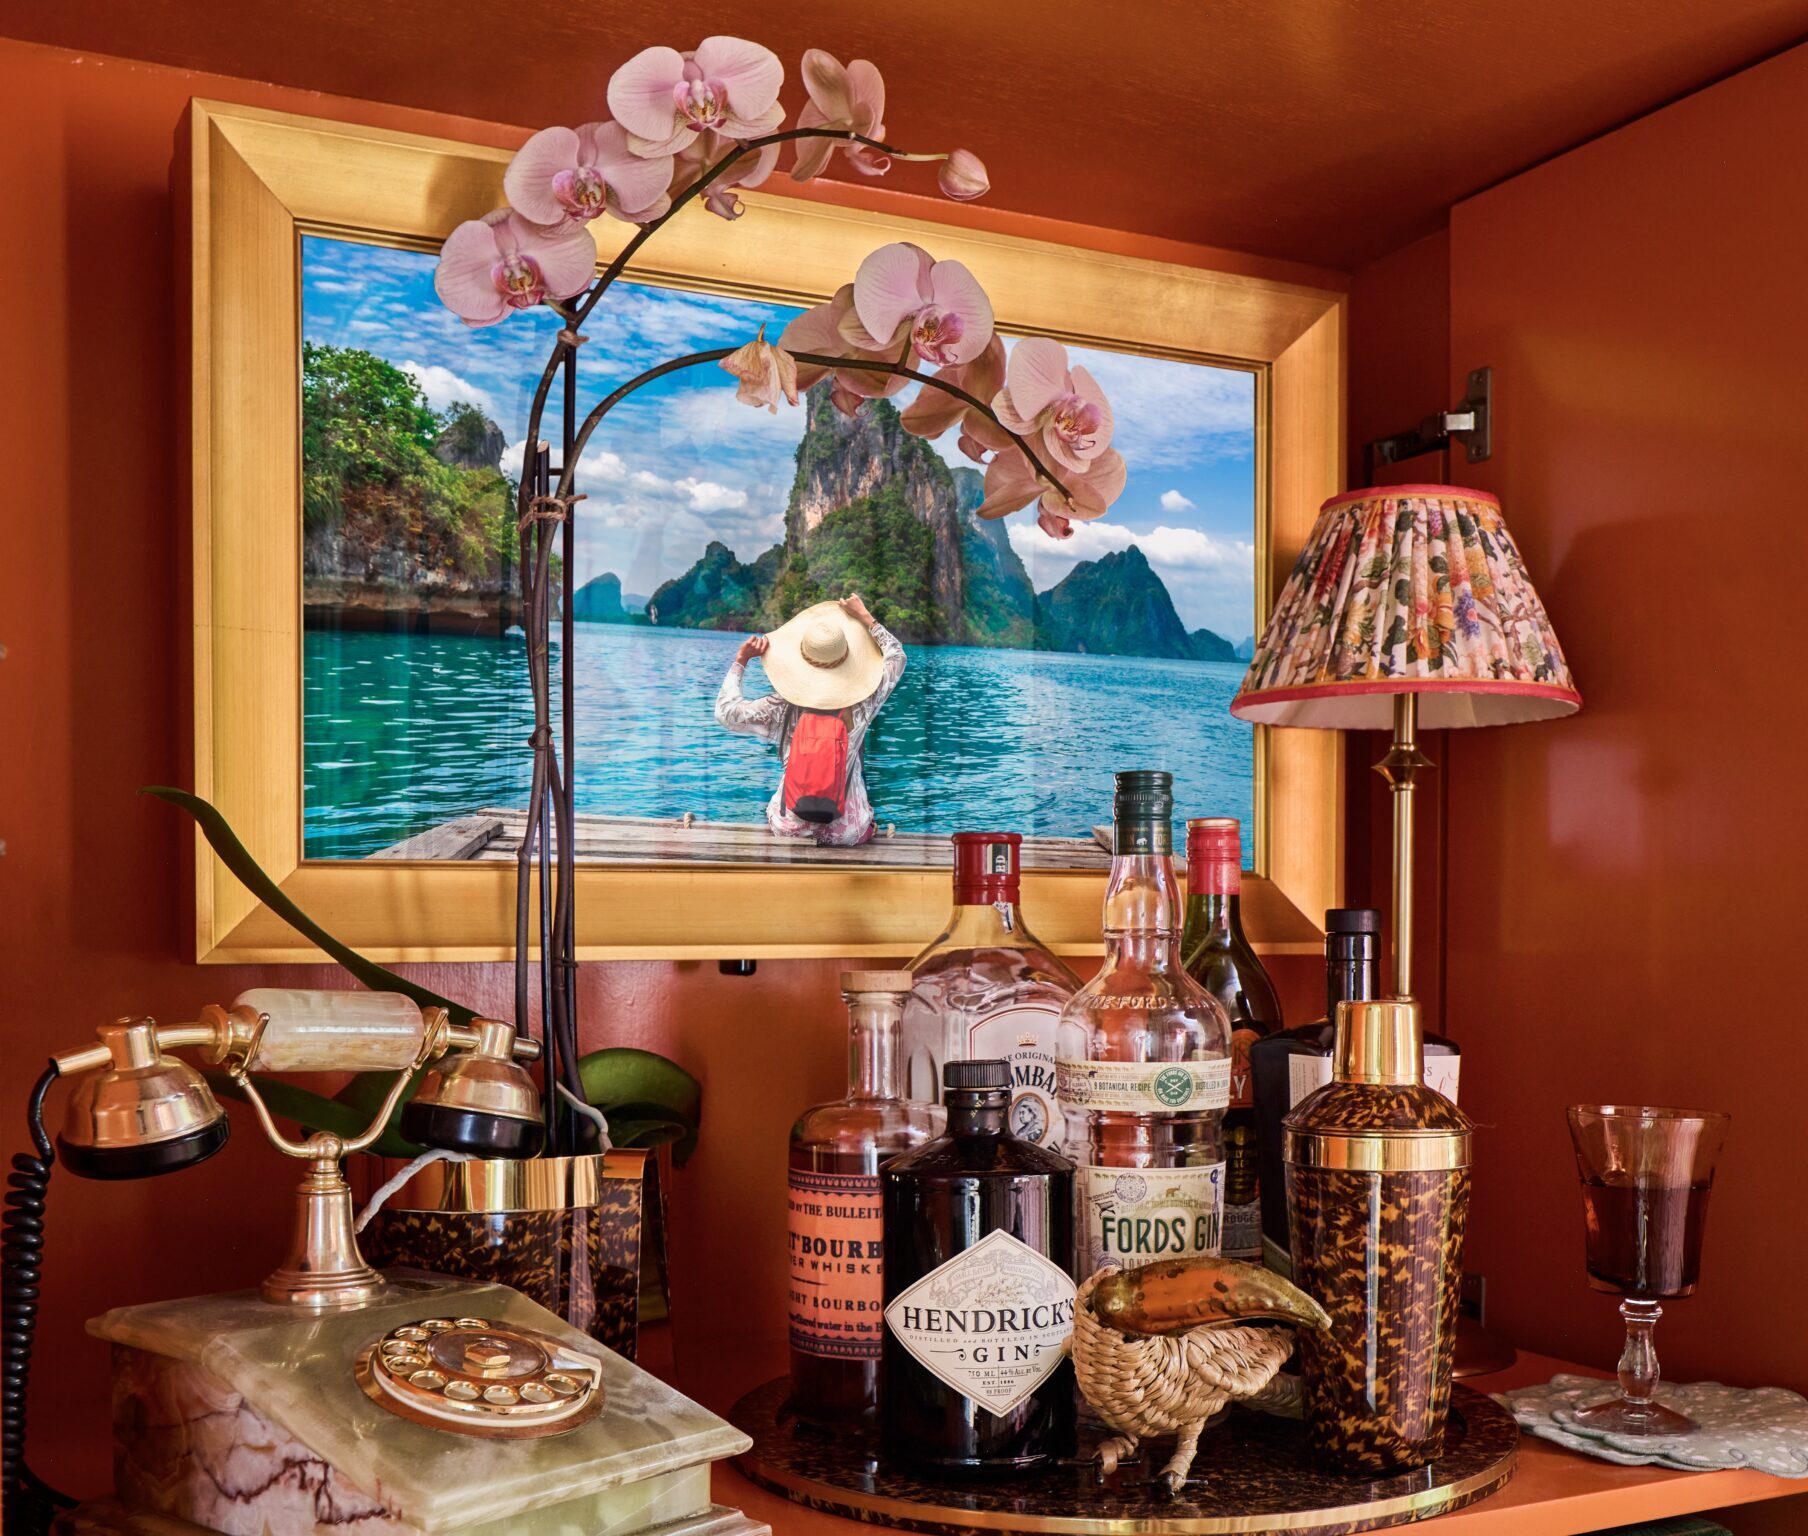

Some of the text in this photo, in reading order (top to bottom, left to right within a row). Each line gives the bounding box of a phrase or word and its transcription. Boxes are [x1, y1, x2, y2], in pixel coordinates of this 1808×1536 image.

[1015, 1052, 1056, 1064] ORIGINA
[1094, 1082, 1151, 1091] 9 BOTANICAL RECIPE
[804, 1203, 822, 1216] THE
[826, 1206, 882, 1219] BULLEIT
[1102, 1211, 1220, 1254] FORDS GIN
[903, 1298, 1074, 1334] HENDRICK'S
[909, 1335, 958, 1344] DISTILLED
[973, 1345, 1029, 1363] GIN
